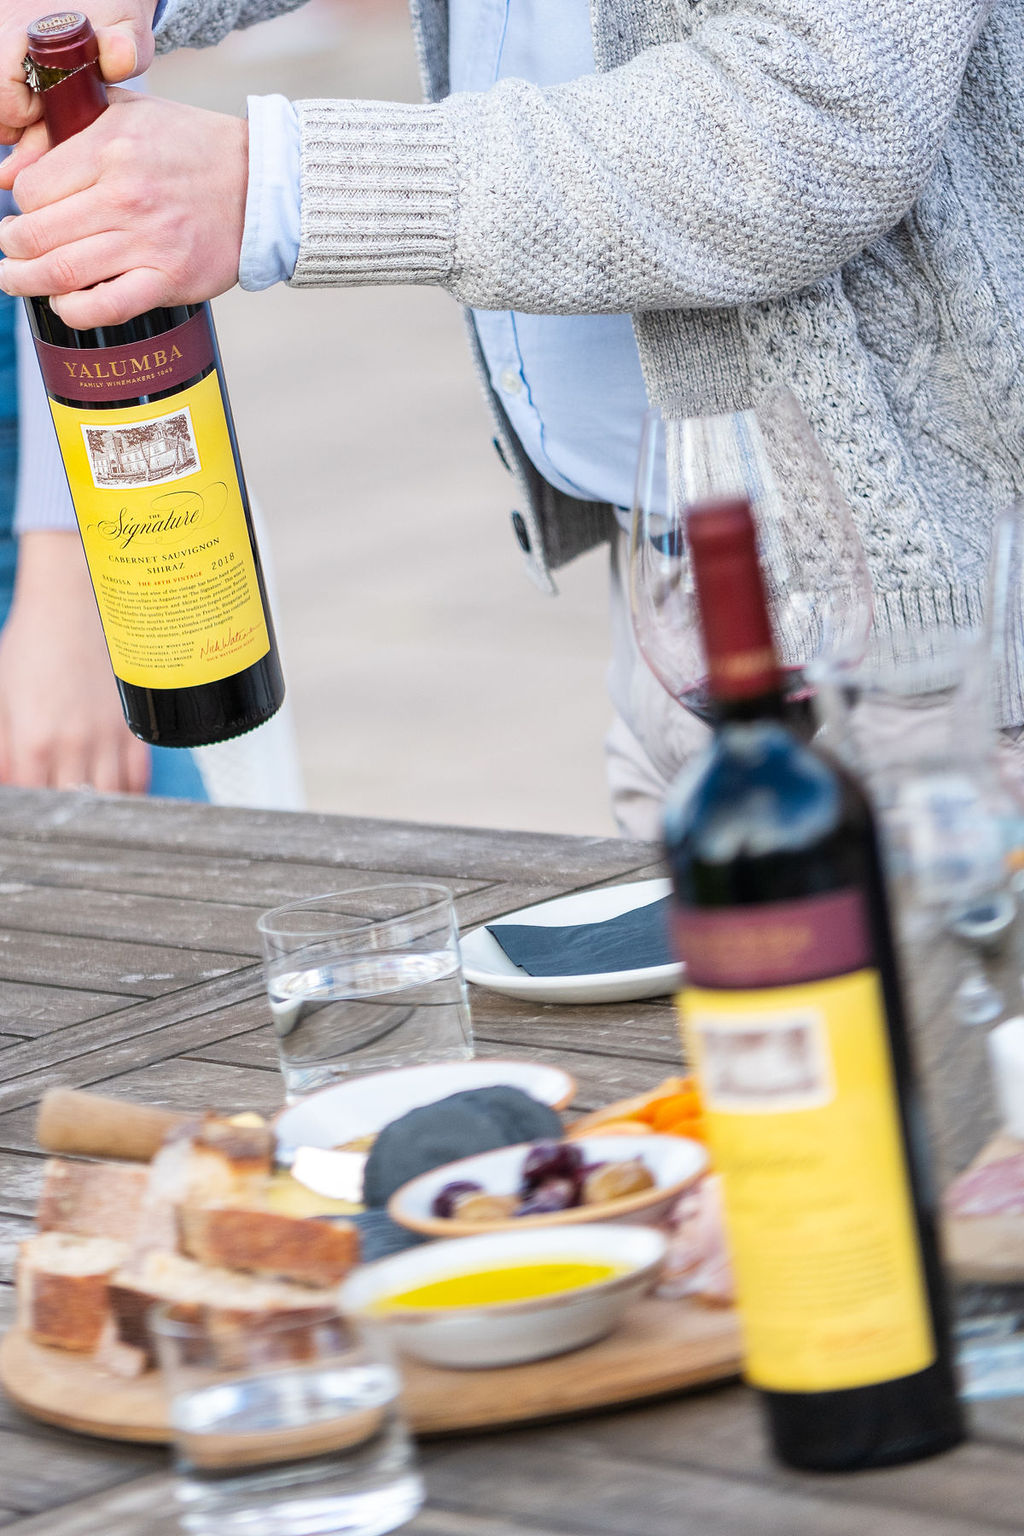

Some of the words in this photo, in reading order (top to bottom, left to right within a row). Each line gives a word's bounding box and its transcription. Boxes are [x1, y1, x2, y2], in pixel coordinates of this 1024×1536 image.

[63, 344, 183, 379] YALUMBA
[106, 373, 156, 387] WINEMAKERS
[92, 502, 202, 549] Signature
[108, 554, 158, 564] CABERNET
[162, 537, 220, 561] SAUVIGNON
[147, 562, 185, 574] SHIRAZ
[173, 571, 202, 583] VINTAGE
[211, 552, 235, 571] 2018
